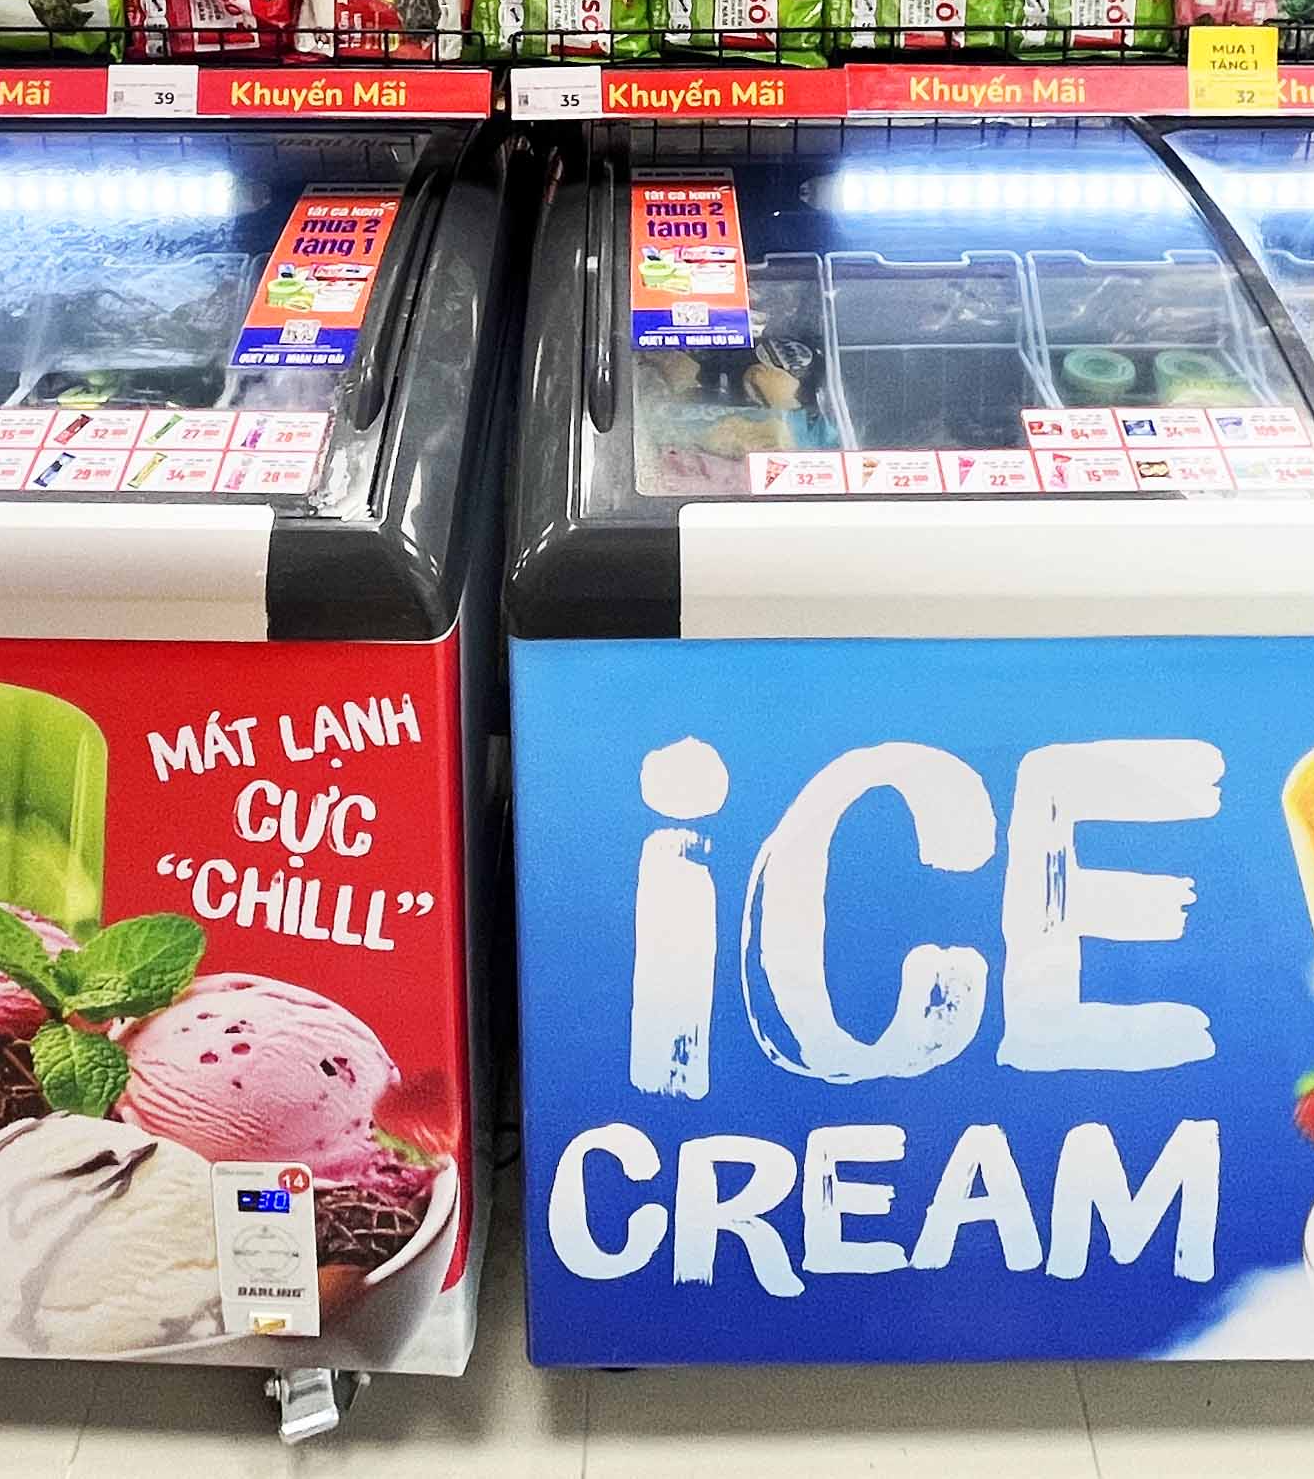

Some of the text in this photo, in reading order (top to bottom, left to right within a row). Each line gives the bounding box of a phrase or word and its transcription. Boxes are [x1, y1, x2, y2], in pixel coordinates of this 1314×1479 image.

[1211, 45, 1255, 56] MUA 1
[1210, 58, 1258, 72] TẶNG 1
[0, 78, 51, 105] Mãi
[154, 90, 174, 105] 39
[232, 78, 406, 110] Khuyến Mãi
[609, 80, 784, 111] Khuyến Mãi
[911, 75, 1086, 106] Khuyến Mãi
[1237, 91, 1255, 104] 32
[559, 93, 580, 107] 35
[646, 202, 724, 216] mua 2
[300, 218, 381, 233] mua 2
[716, 220, 727, 237] 1
[363, 237, 375, 254] 1
[146, 693, 422, 783] MÁT LẠNH
[233, 779, 377, 869] CỰC
[282, 1174, 306, 1189] 14
[547, 1119, 1220, 1298] CREAM
[237, 1286, 303, 1299] DARLING
